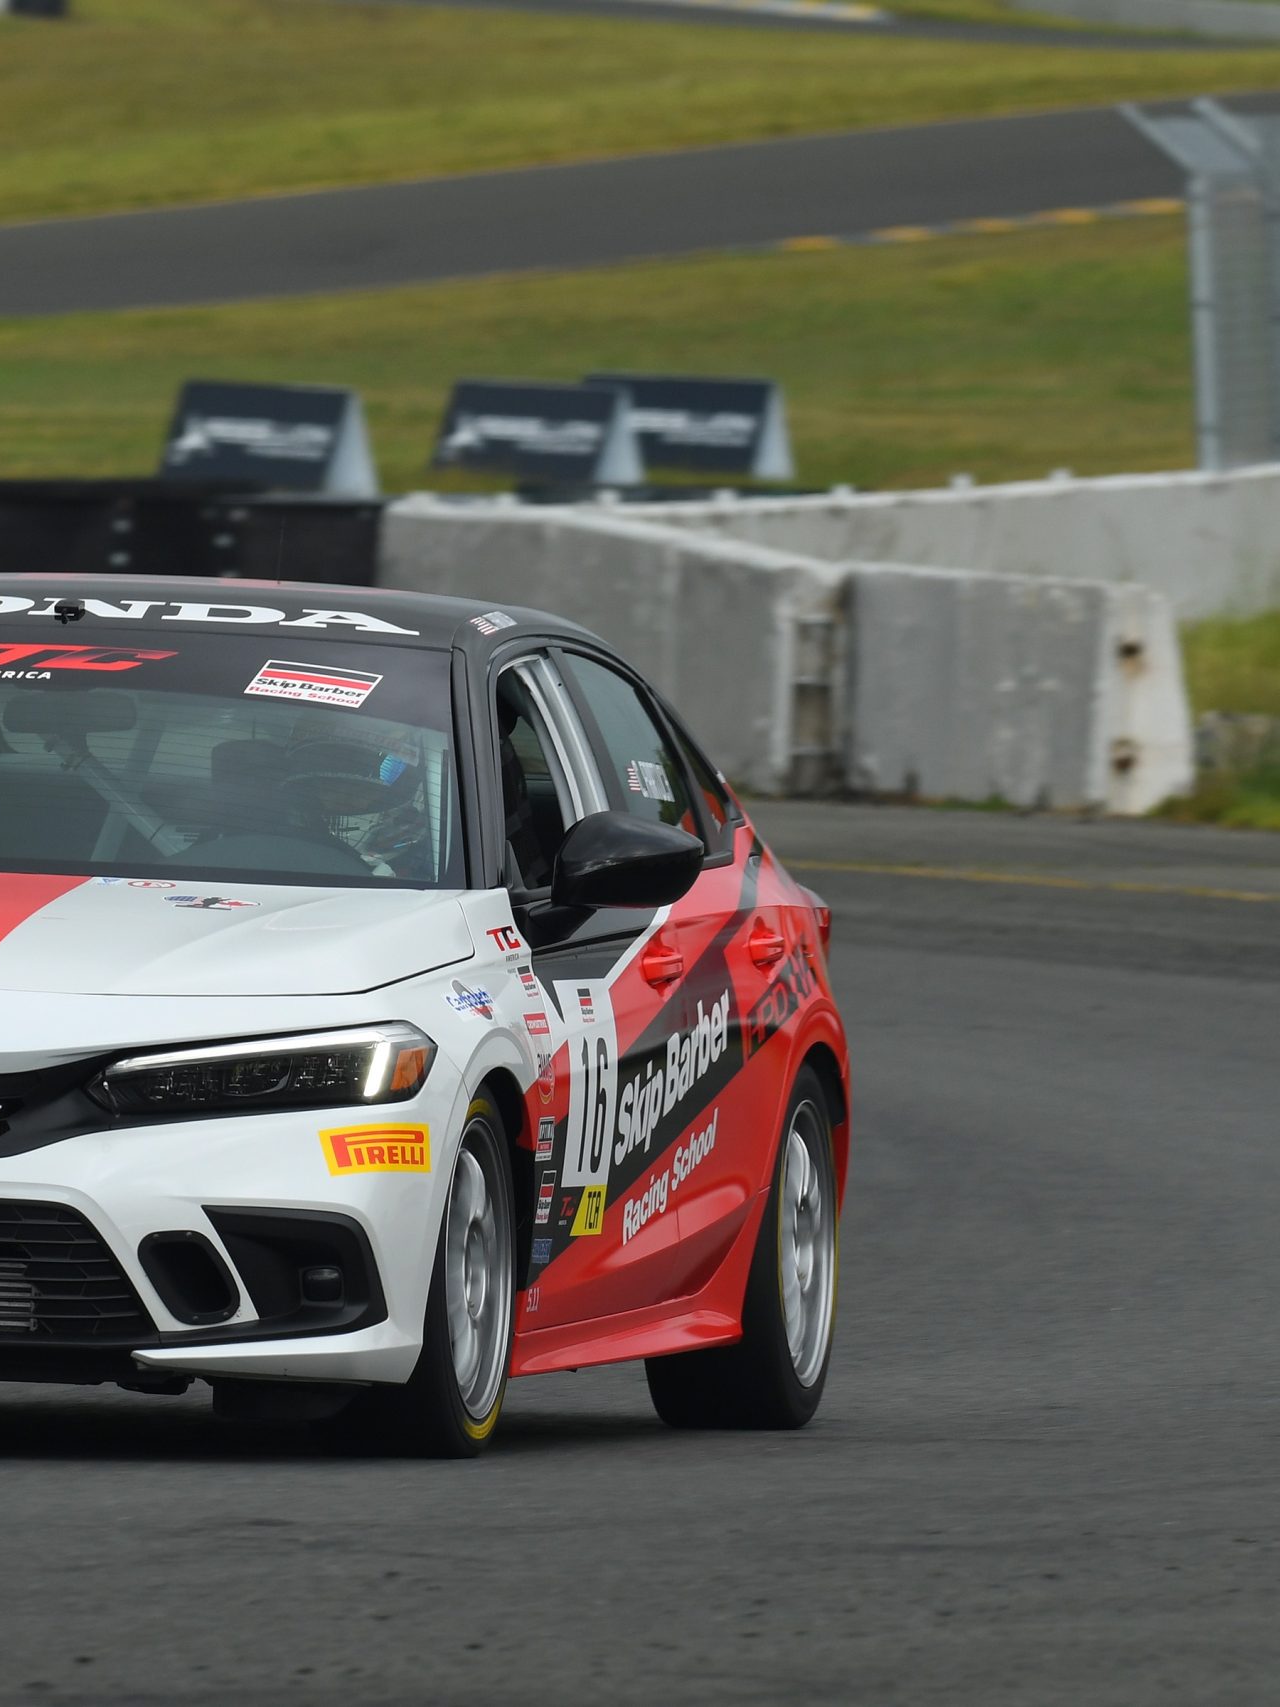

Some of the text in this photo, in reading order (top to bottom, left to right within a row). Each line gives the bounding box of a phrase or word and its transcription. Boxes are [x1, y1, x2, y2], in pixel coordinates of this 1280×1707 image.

[248, 686, 360, 705] Racing School
[254, 678, 366, 698] Skip Barber
[486, 925, 521, 951] TC
[614, 989, 730, 1166] Skip Barber
[578, 1036, 608, 1173] 16
[330, 1130, 425, 1168] PIRELLI
[623, 1107, 718, 1246] Racing School
[585, 1191, 602, 1229] TCA
